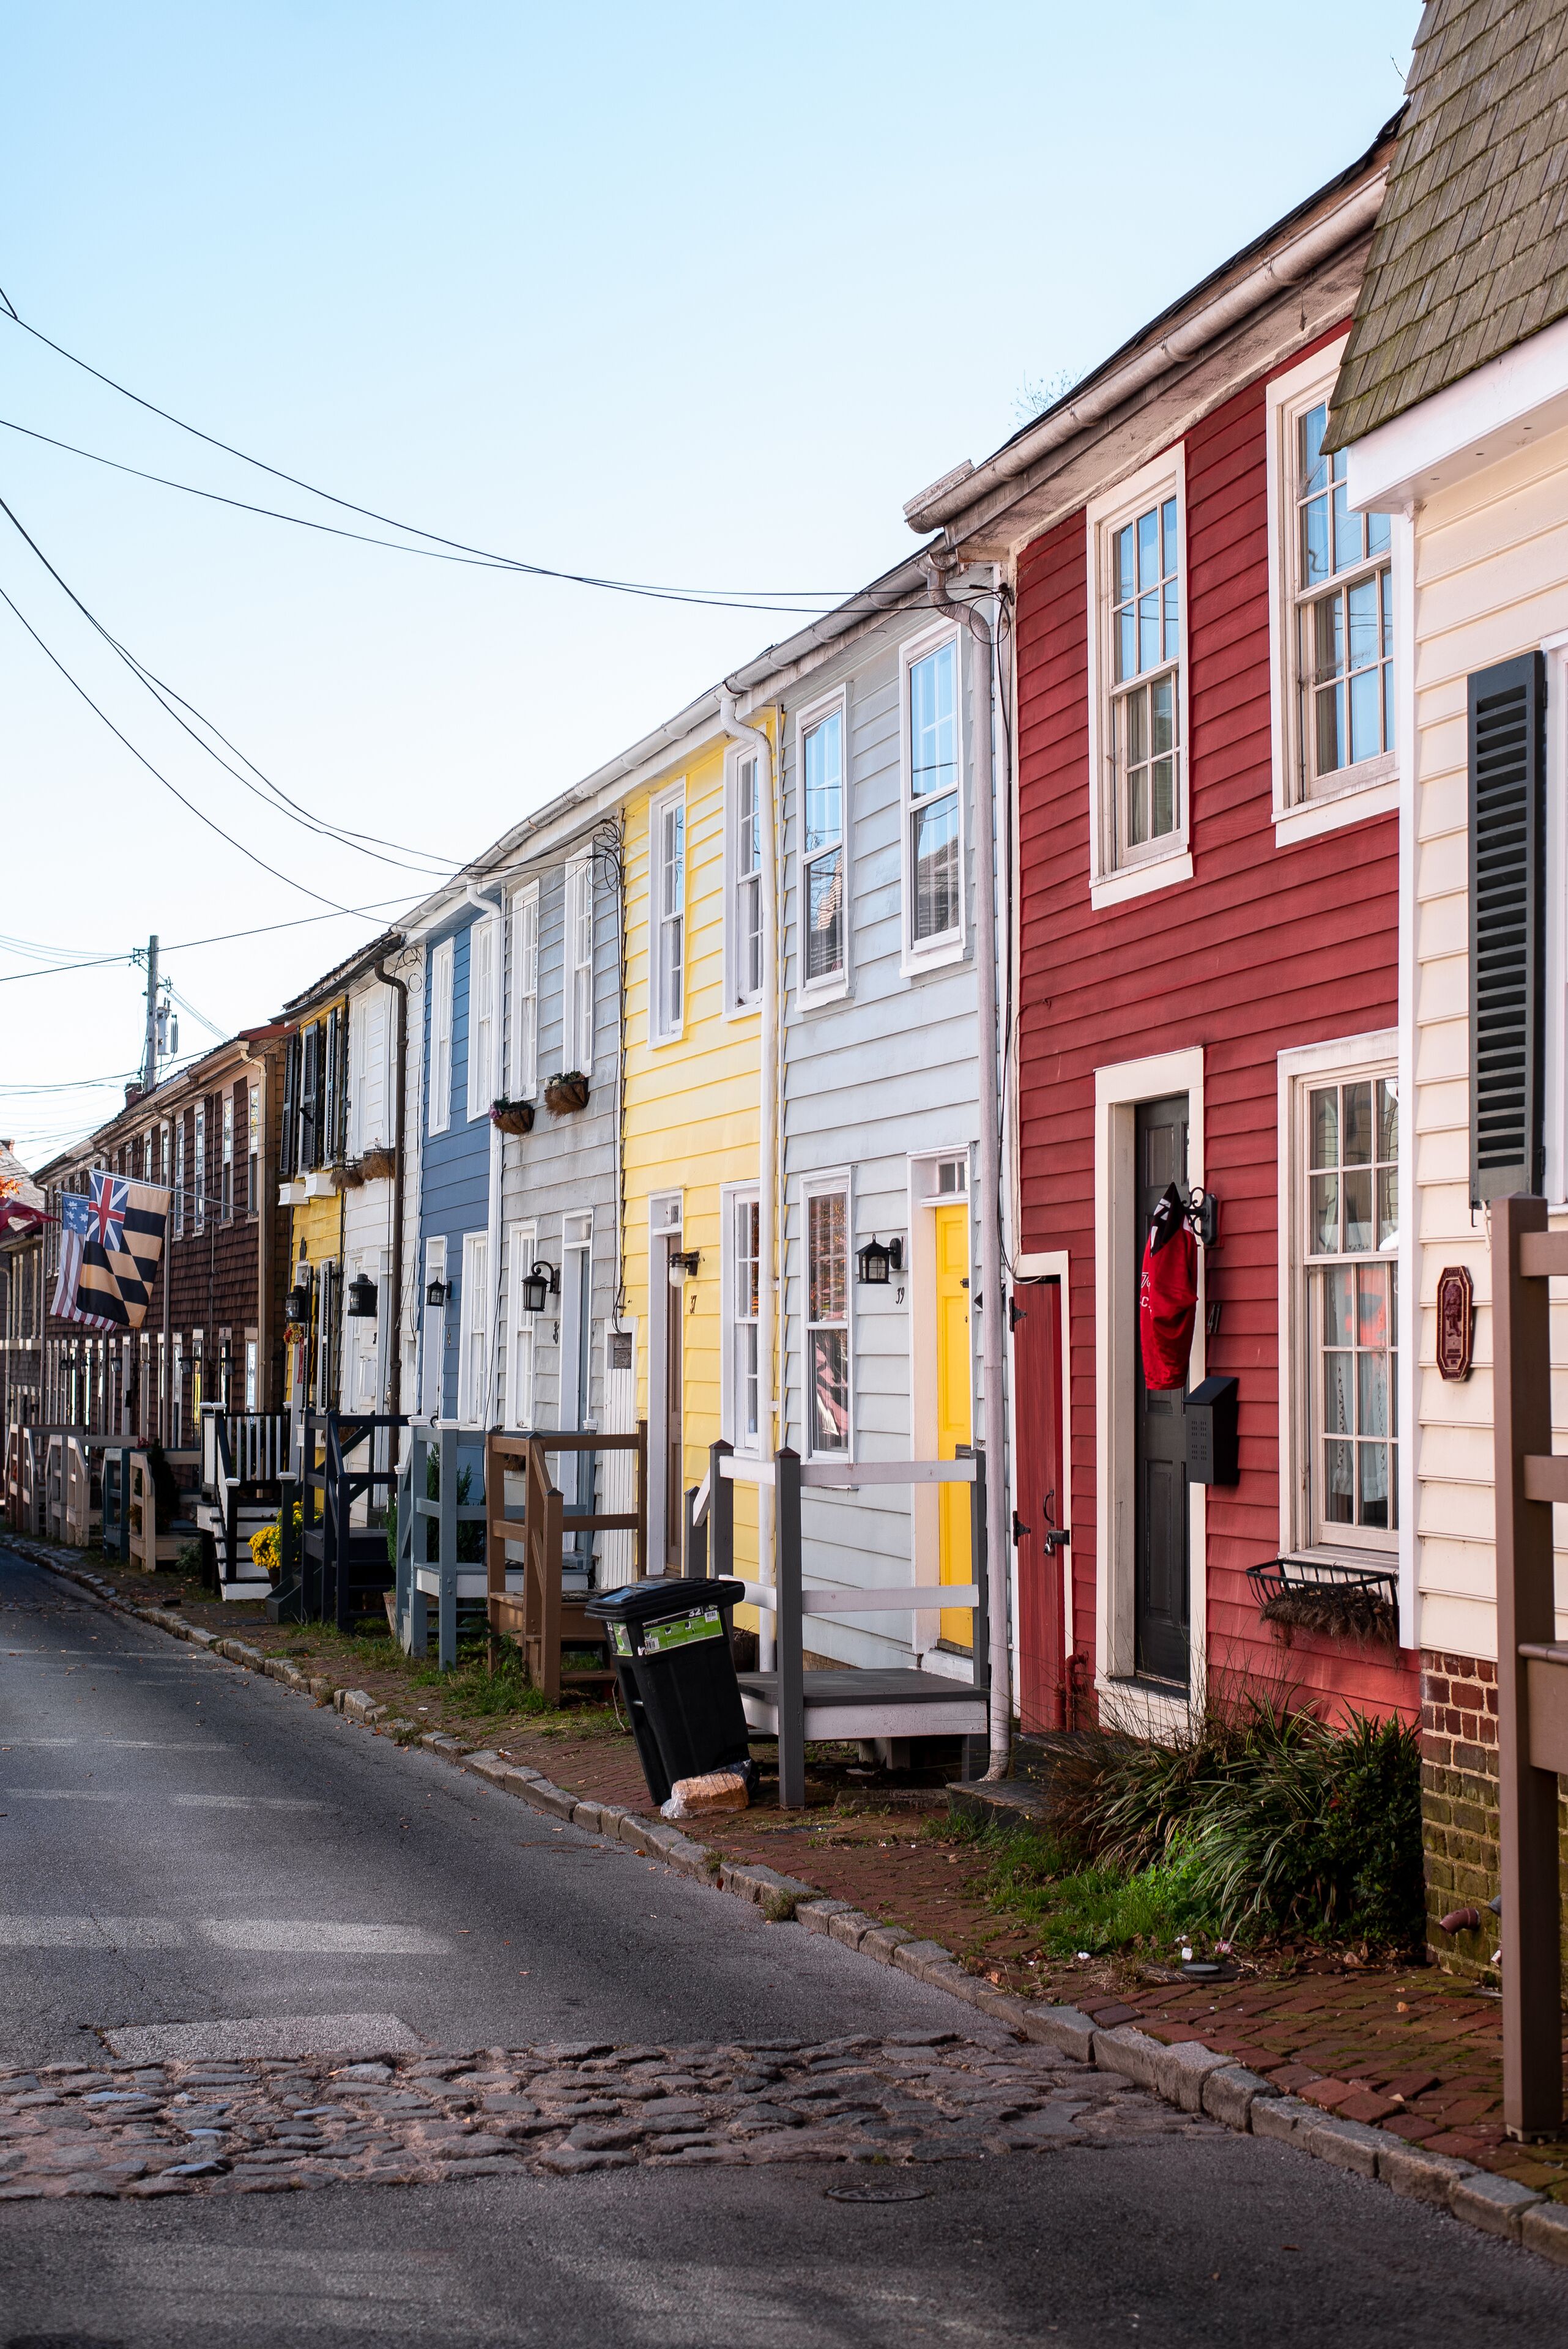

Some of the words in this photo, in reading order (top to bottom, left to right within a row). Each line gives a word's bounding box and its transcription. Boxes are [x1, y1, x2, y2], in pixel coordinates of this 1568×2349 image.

[895, 1286, 905, 1304] 39
[1207, 1303, 1221, 1334] 41
[689, 1608, 701, 1617] 32
[606, 1620, 614, 1631] 32
